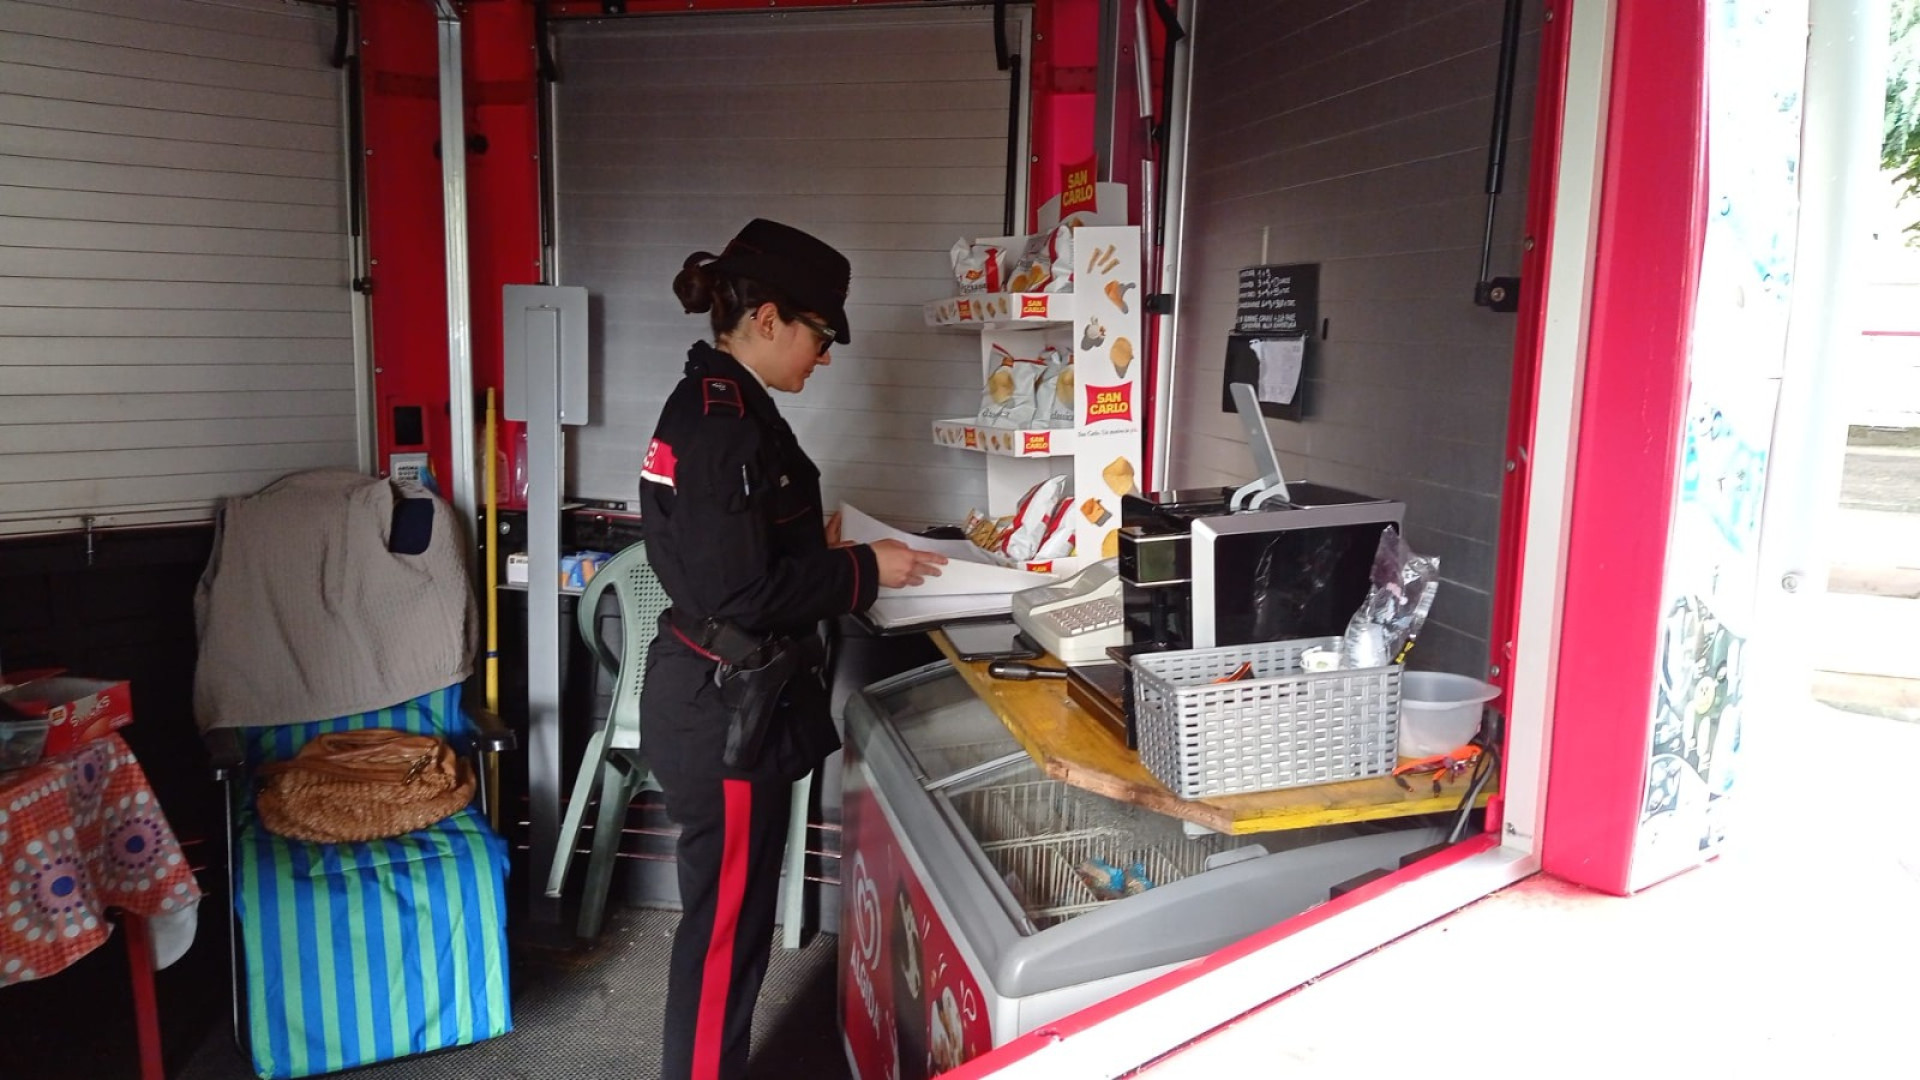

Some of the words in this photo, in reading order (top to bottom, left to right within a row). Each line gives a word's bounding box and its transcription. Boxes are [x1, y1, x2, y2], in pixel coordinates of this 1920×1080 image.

[1068, 169, 1088, 189] SAN
[1063, 184, 1093, 207] CARLO
[1097, 392, 1122, 404] SAN
[1089, 402, 1128, 415] CARLO
[850, 940, 881, 1040] ALGIDA
